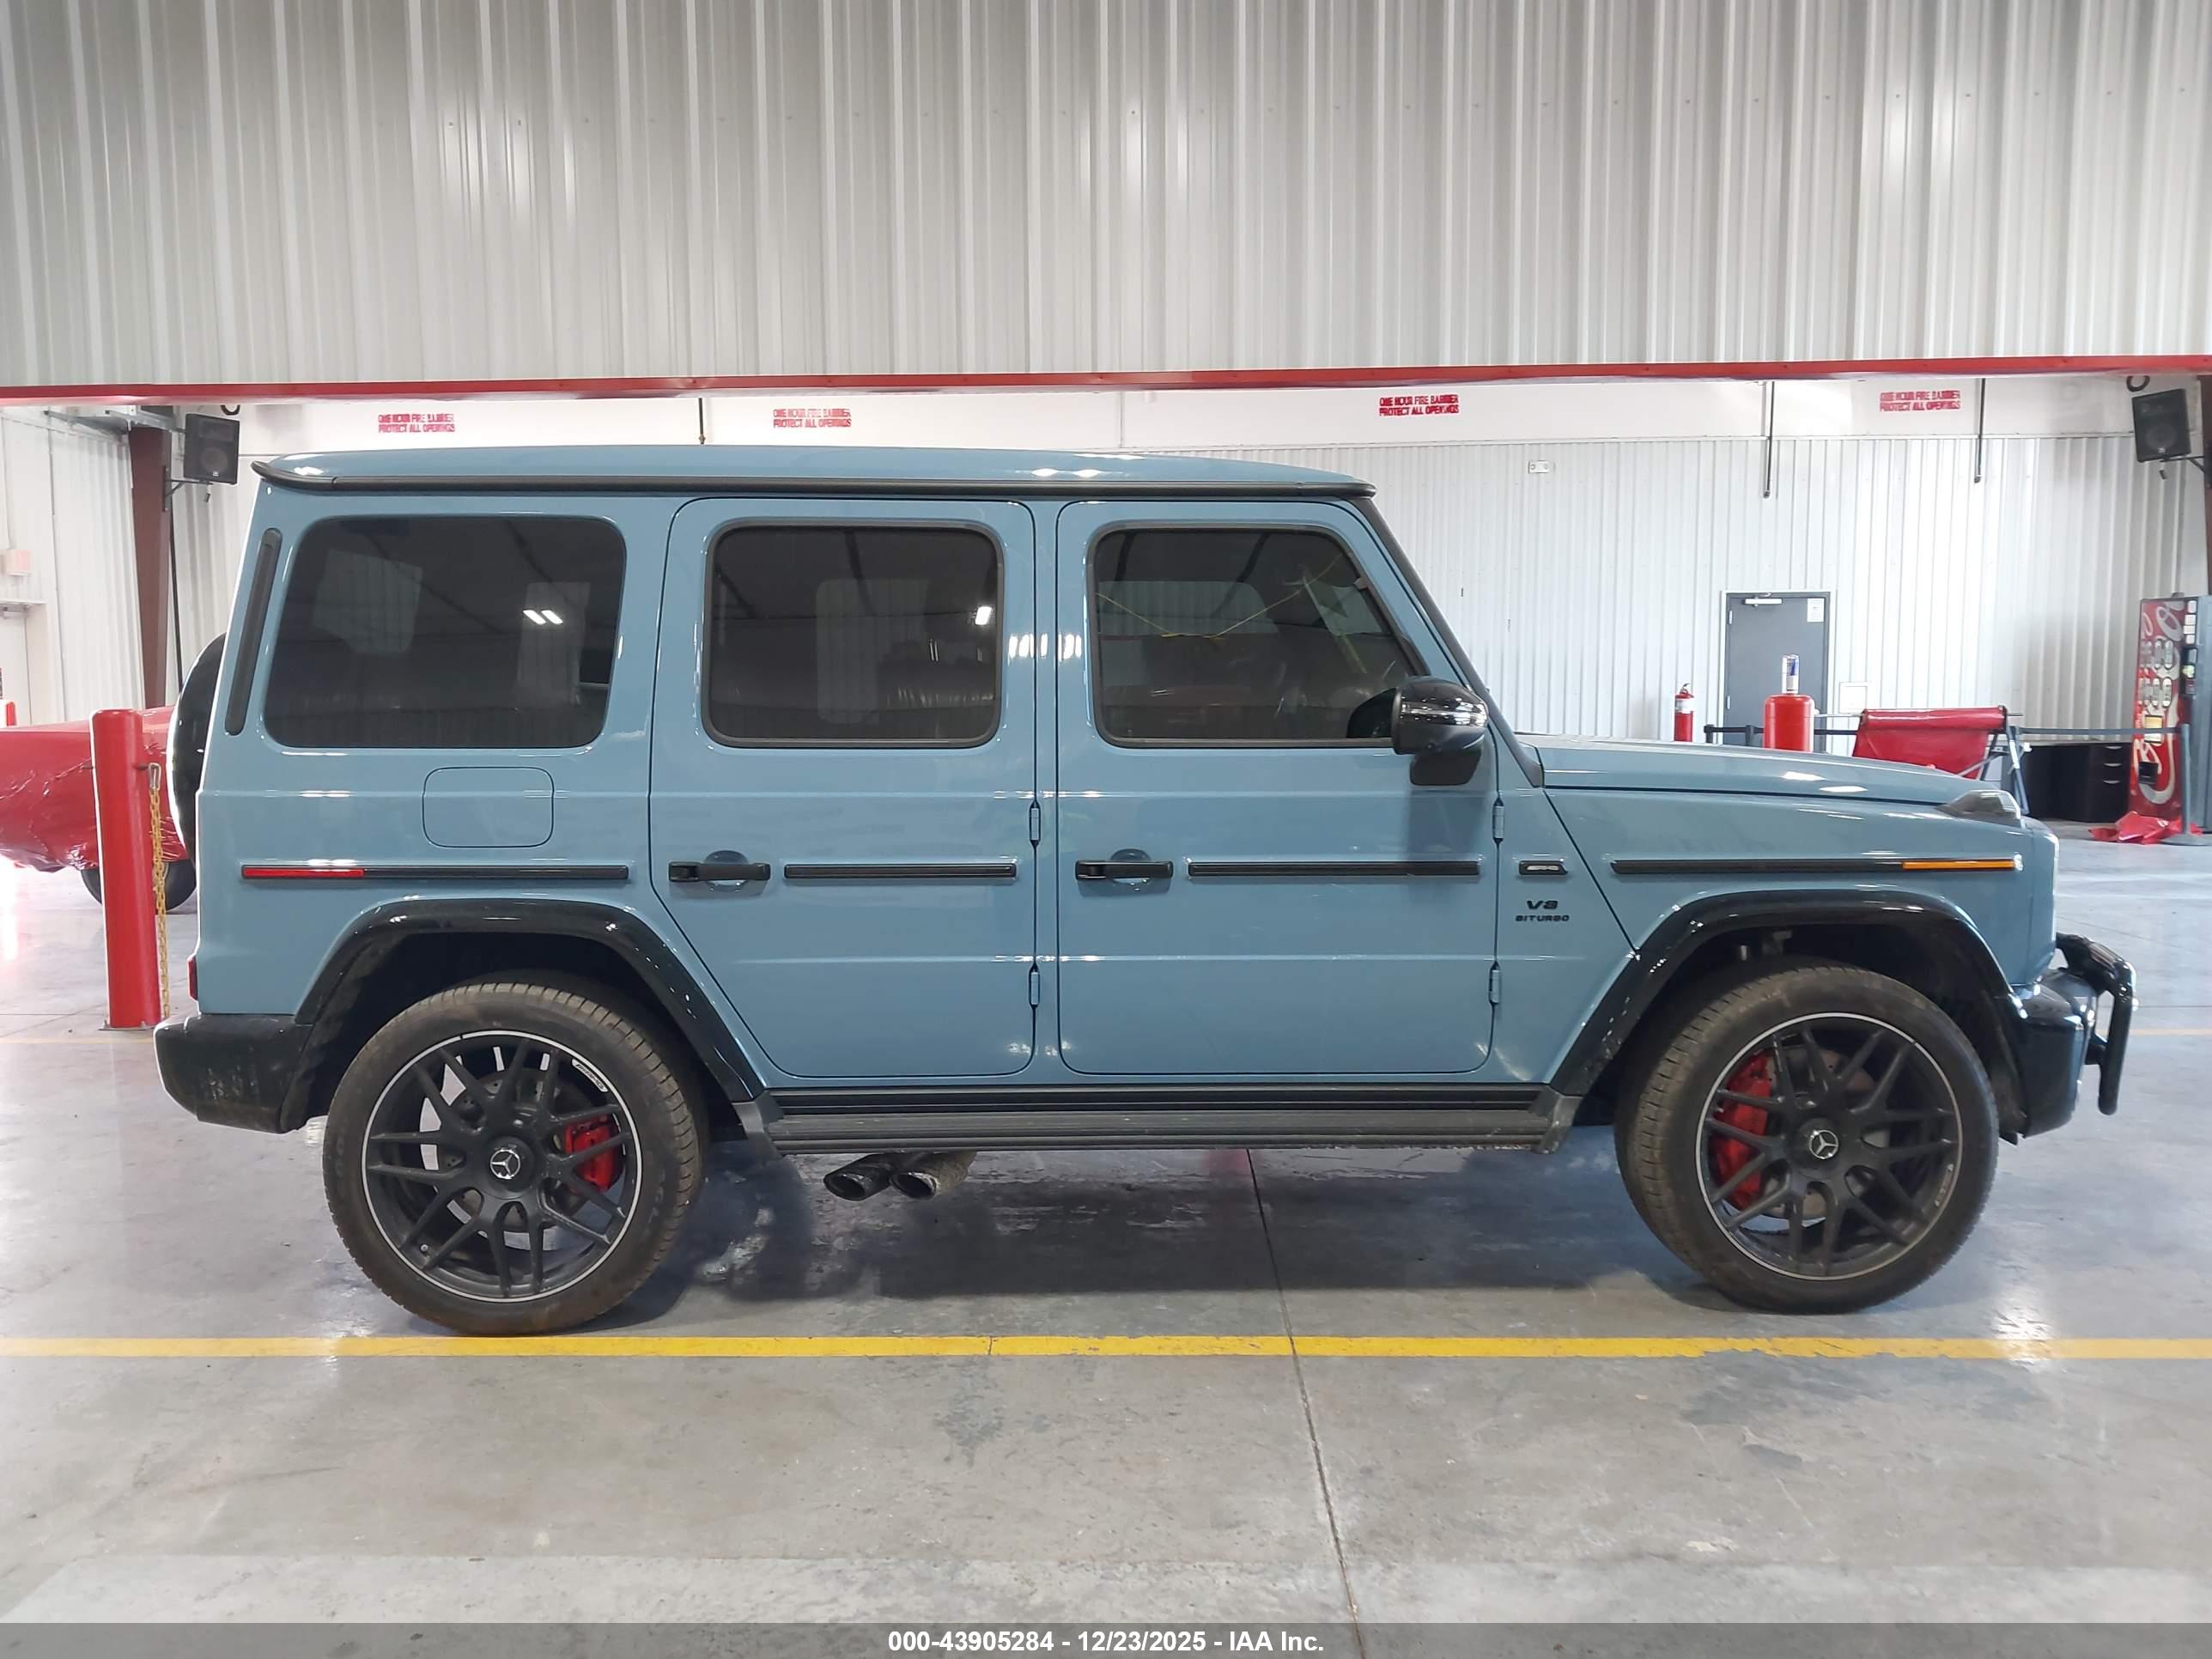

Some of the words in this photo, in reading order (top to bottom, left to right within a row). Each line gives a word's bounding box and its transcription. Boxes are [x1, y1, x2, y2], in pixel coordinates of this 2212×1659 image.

[1379, 397, 1393, 406] ONE
[1414, 396, 1429, 404] FIRE
[1379, 406, 1410, 416] PROTECT
[1411, 406, 1424, 415] ALL
[1425, 404, 1459, 414] OPENINGS
[1527, 900, 1559, 909] V8
